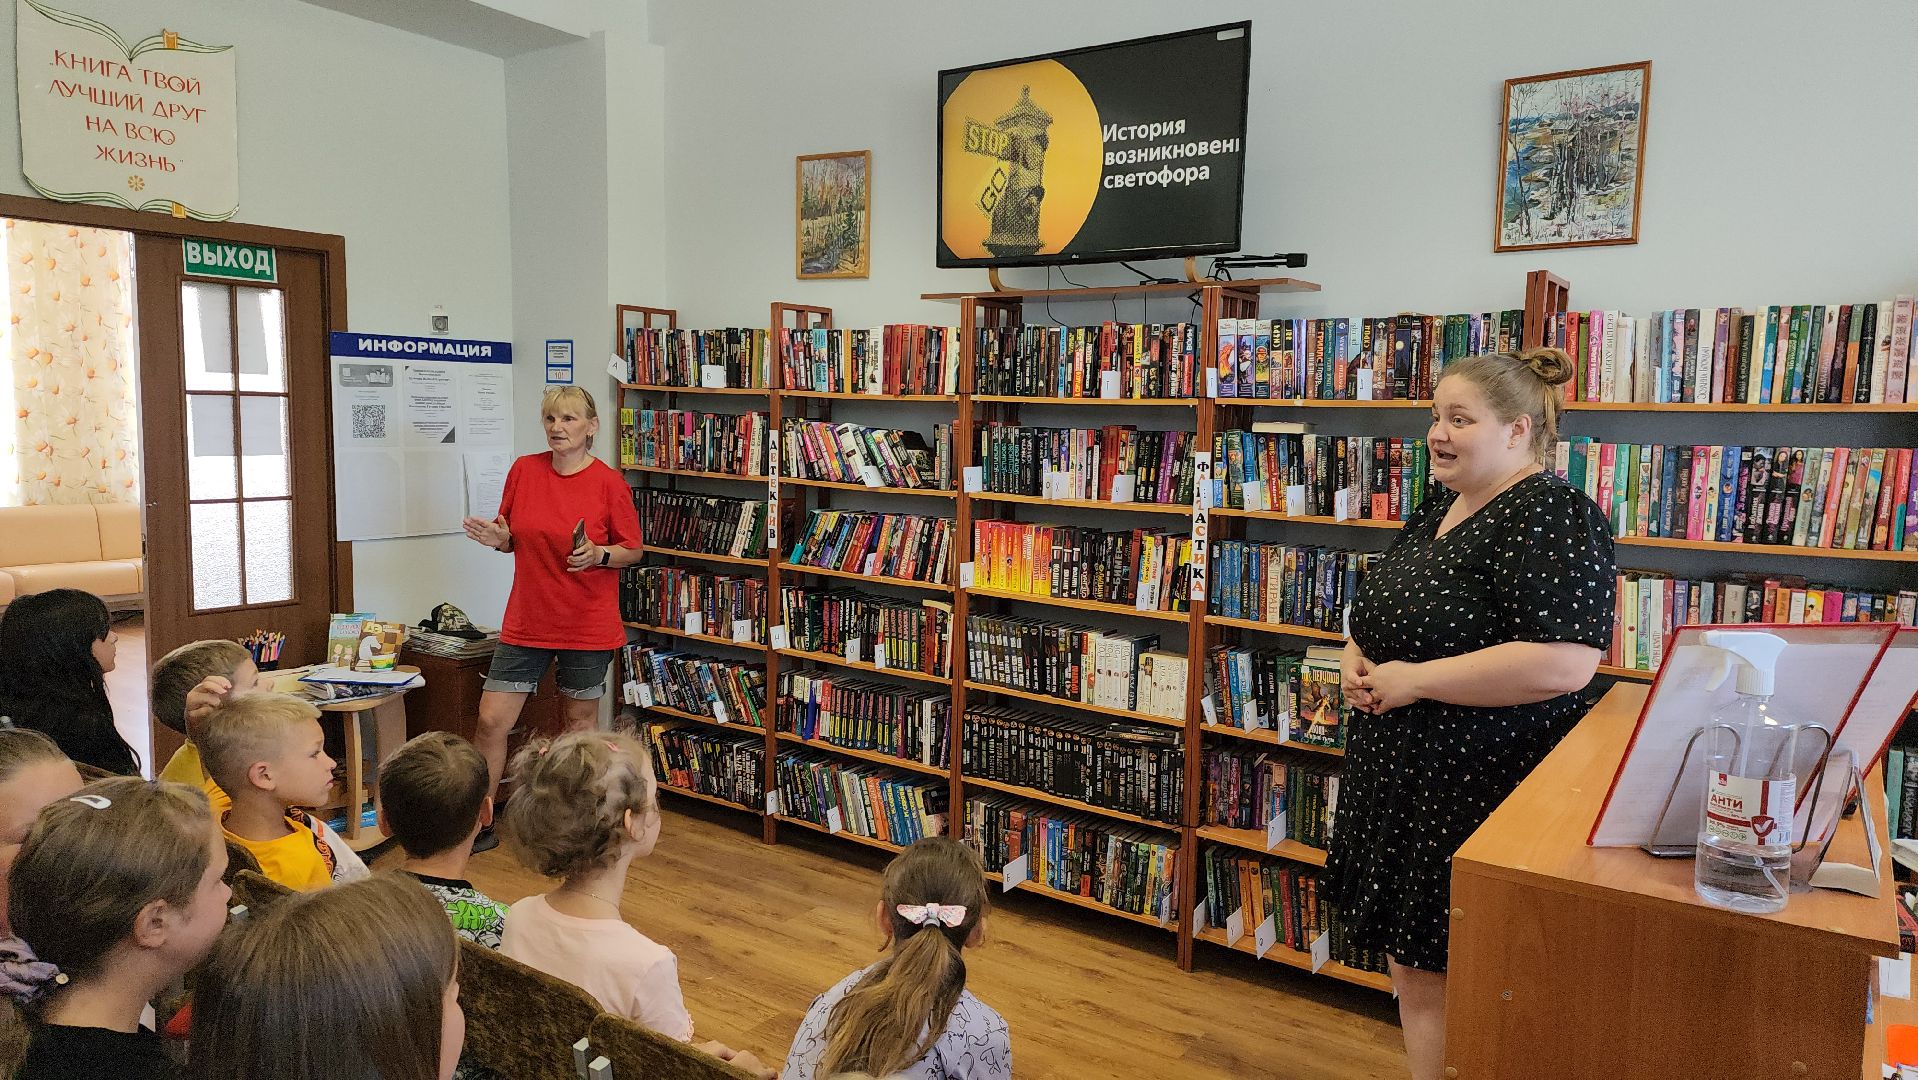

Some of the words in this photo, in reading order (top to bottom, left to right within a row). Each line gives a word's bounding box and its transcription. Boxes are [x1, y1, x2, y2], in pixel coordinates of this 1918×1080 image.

[138, 68, 201, 95] ТВОЙ
[48, 79, 143, 113] ЛУЧШИЙ
[152, 101, 206, 123] ДРУГ
[85, 115, 118, 136] НА
[125, 122, 176, 146] ВСЮ
[1102, 119, 1186, 143] История
[980, 166, 1008, 213] GO
[1103, 165, 1211, 189] светофора
[186, 242, 271, 276] ВЫХОД
[358, 338, 492, 358] ИНФОРМАЦИЯ
[769, 440, 778, 539] ДЕТЕКТИВ
[1192, 461, 1210, 592] ФАТАСТИКА
[1114, 549, 1123, 584] БИМЕР
[1268, 575, 1278, 614] ТИРАН
[1711, 794, 1743, 809] АНТИ
